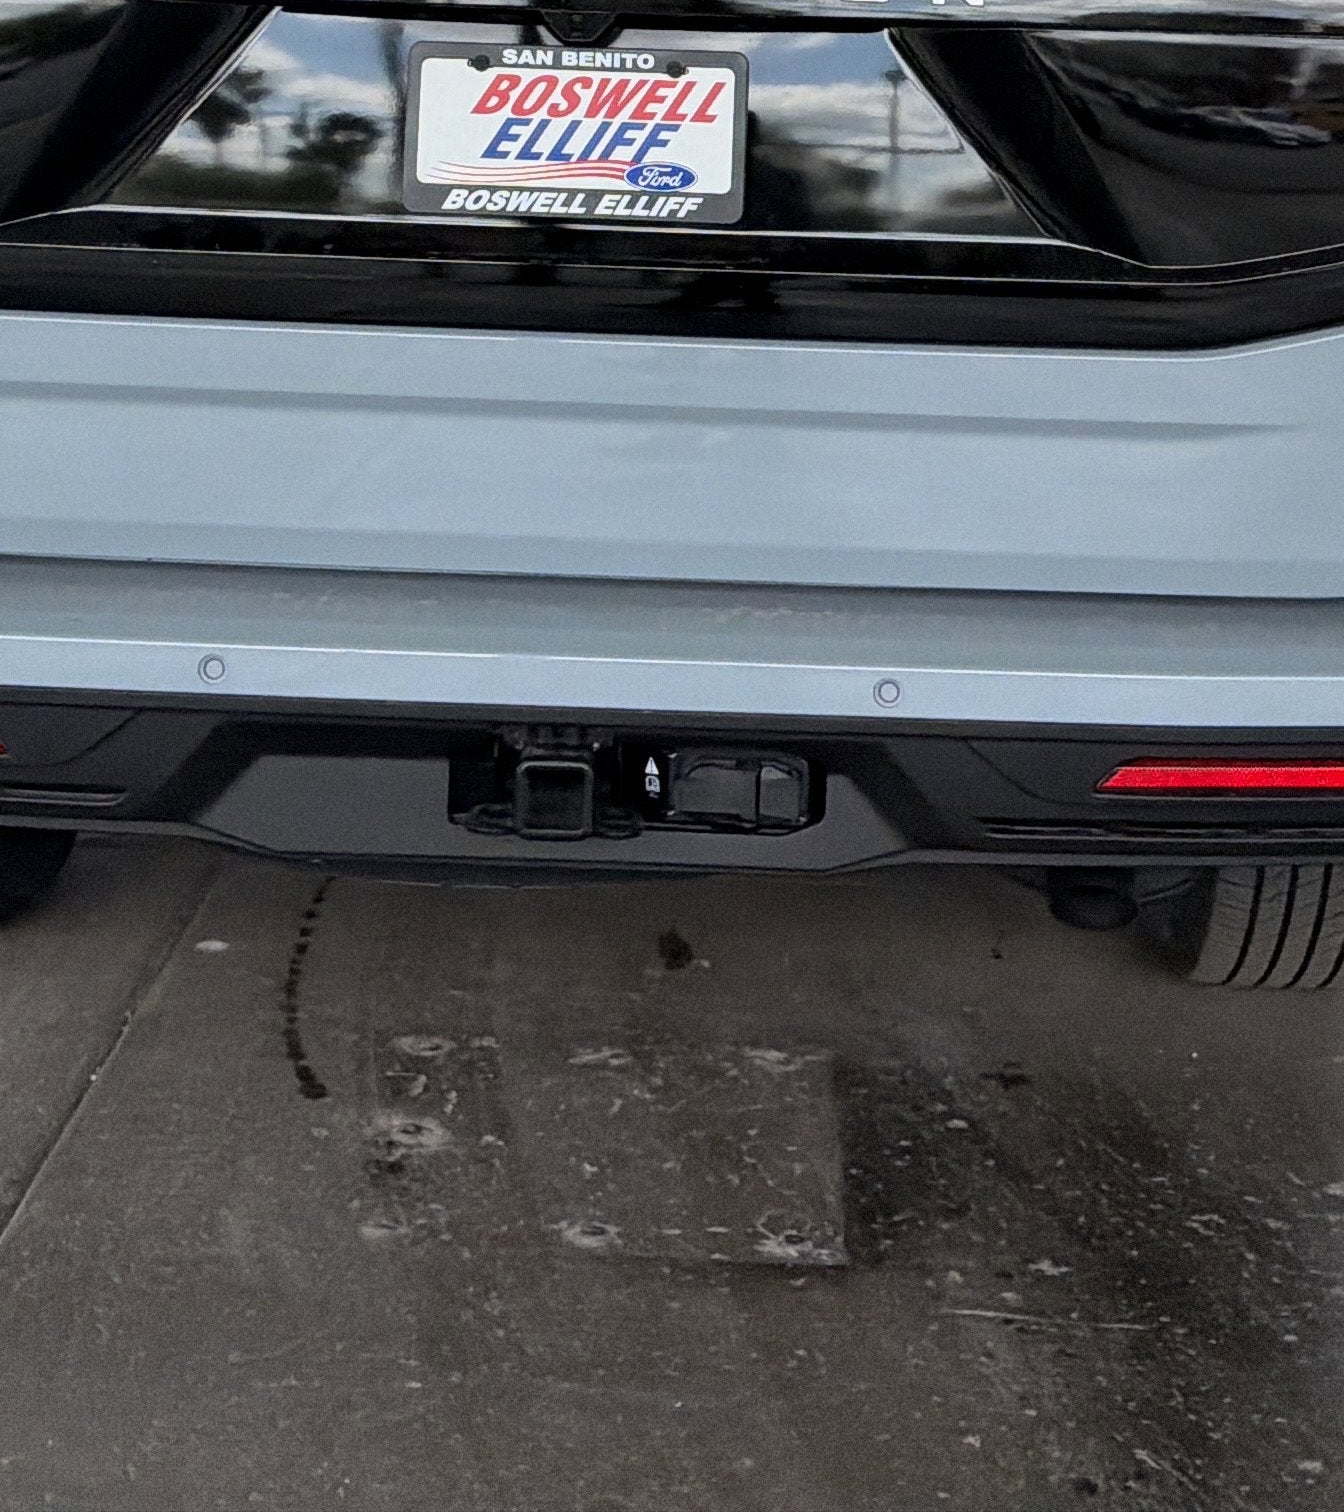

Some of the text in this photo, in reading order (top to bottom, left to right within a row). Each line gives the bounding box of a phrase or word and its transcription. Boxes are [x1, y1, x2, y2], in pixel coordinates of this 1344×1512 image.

[501, 48, 655, 70] SAN BENITO
[470, 73, 727, 124] BOSWELL
[480, 117, 682, 163] ELLIFF
[637, 167, 683, 188] Ford
[441, 189, 704, 219] BOSWELL ELLIFF
